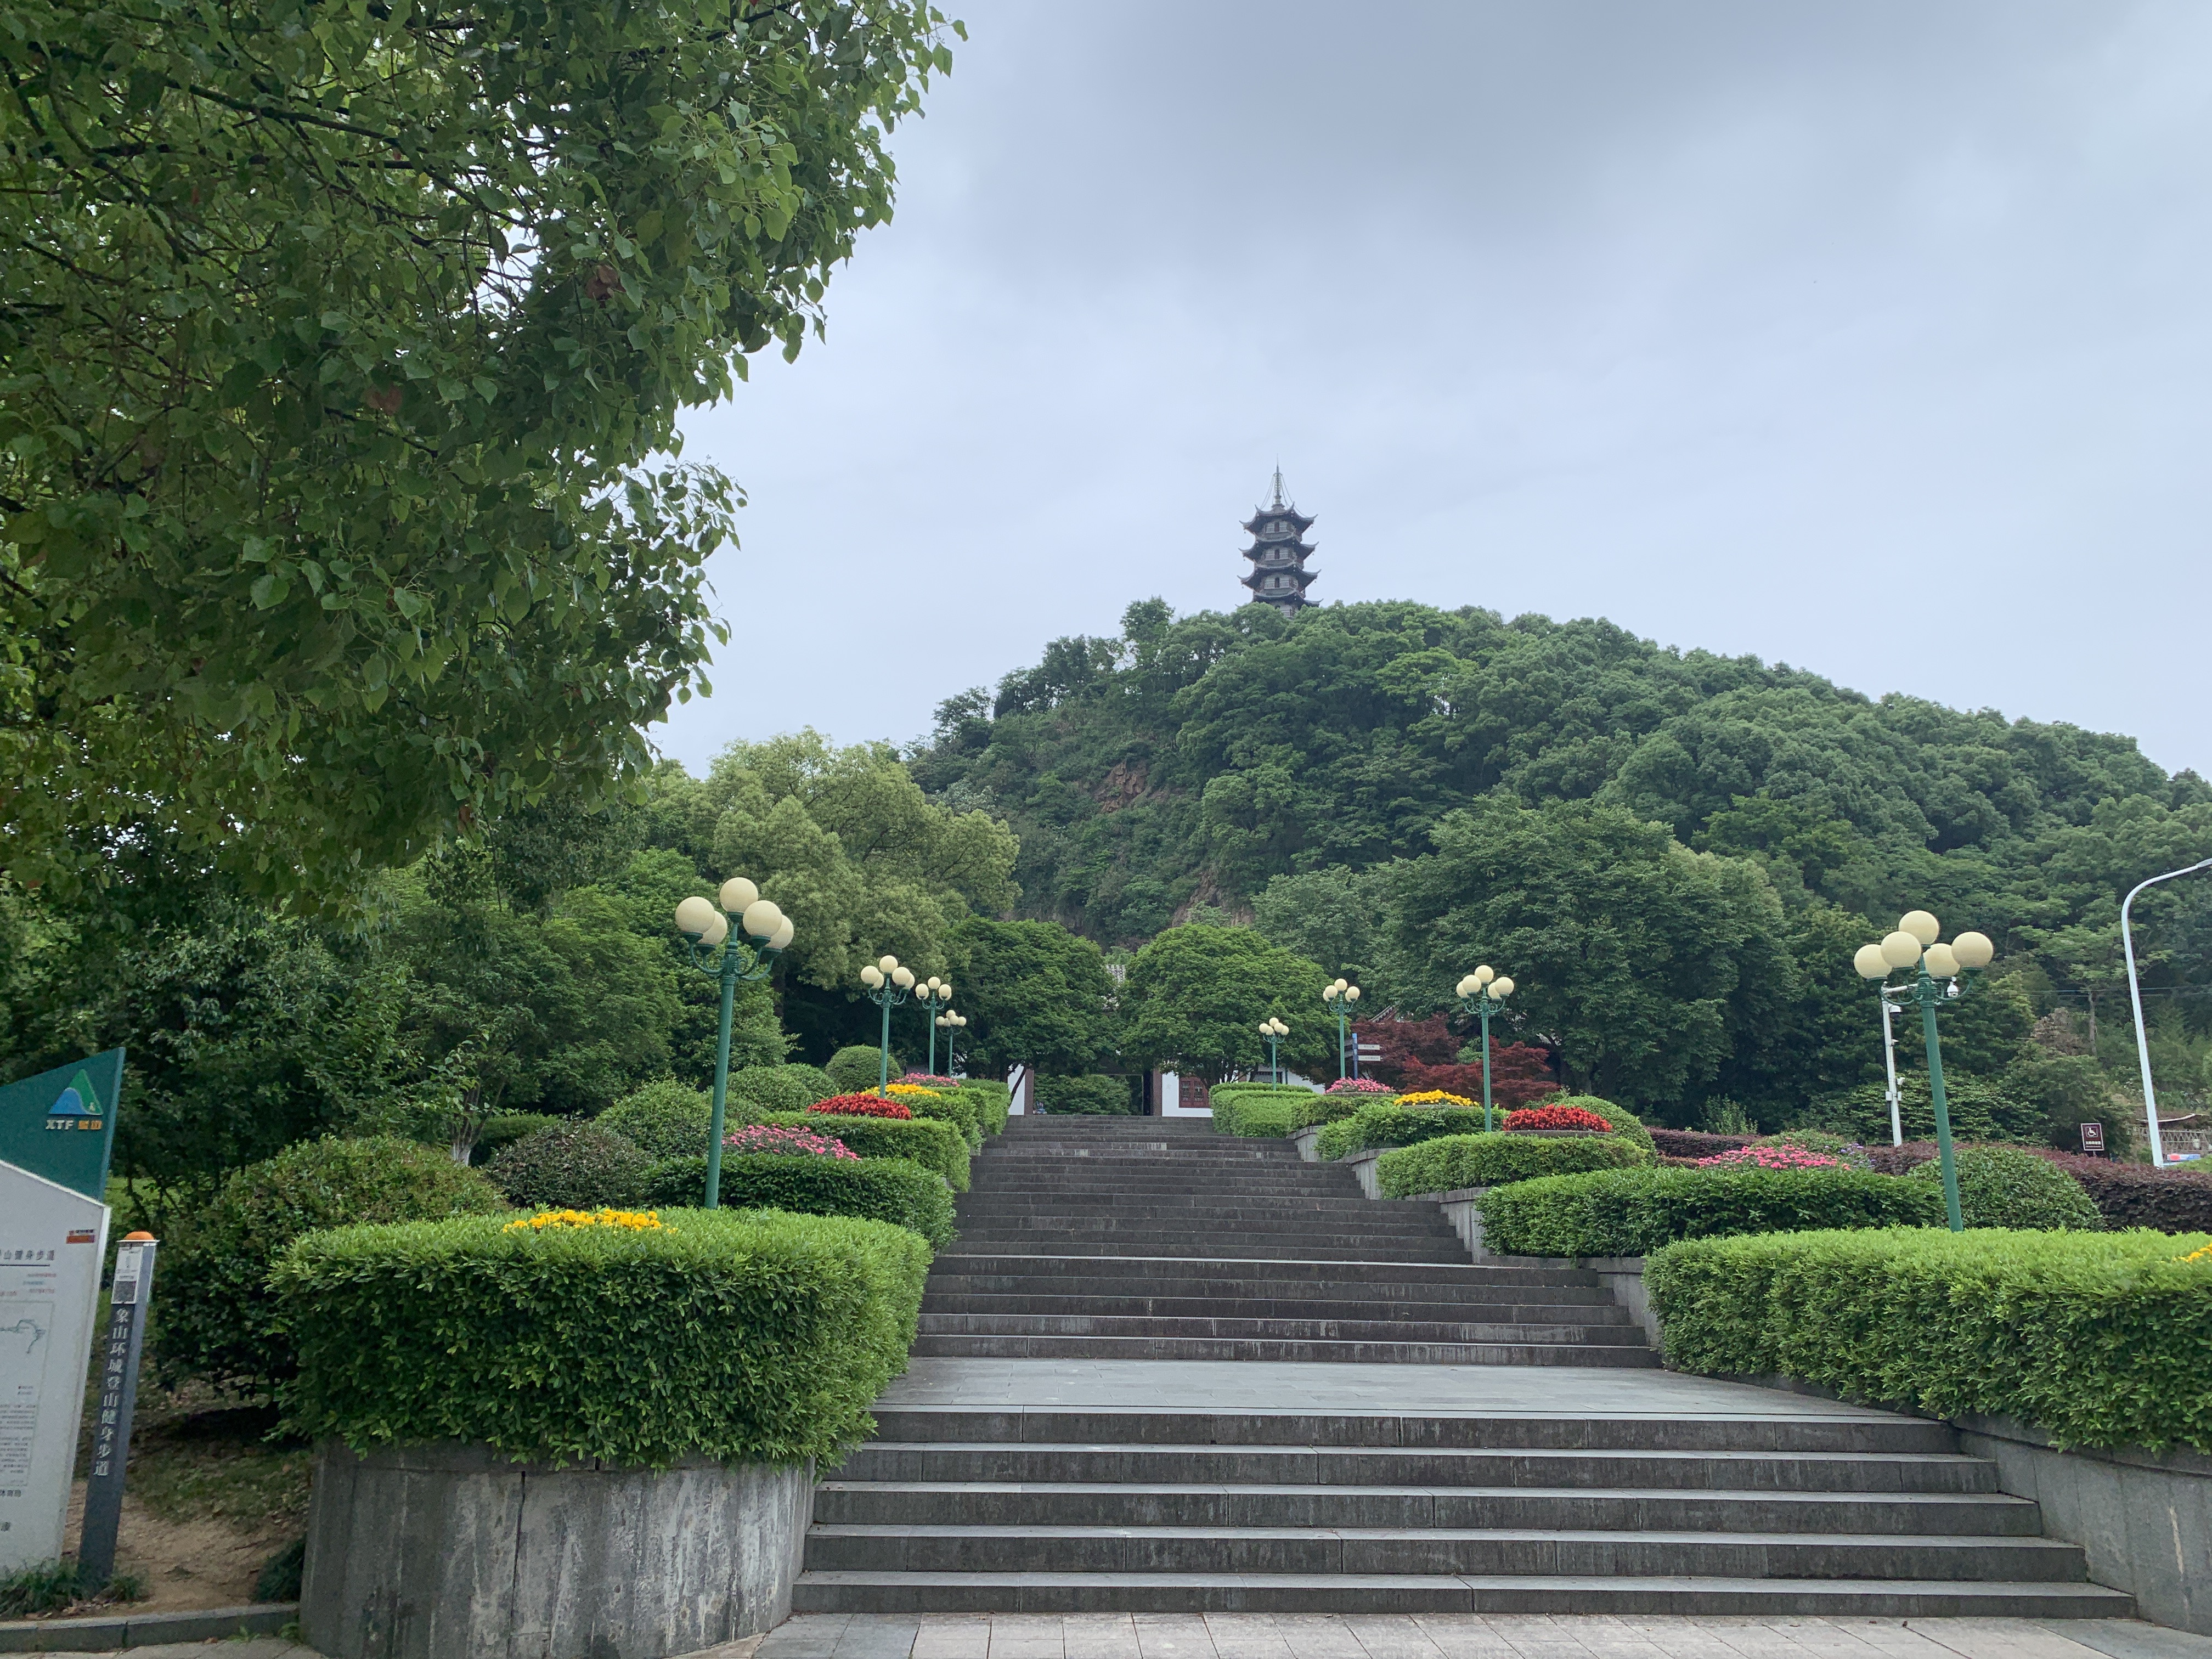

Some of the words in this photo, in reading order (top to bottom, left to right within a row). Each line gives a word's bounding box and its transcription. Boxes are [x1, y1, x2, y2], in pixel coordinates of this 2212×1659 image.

[46, 1120, 74, 1130] XTF
[93, 1308, 129, 1476] 象山环城登山健身步道
